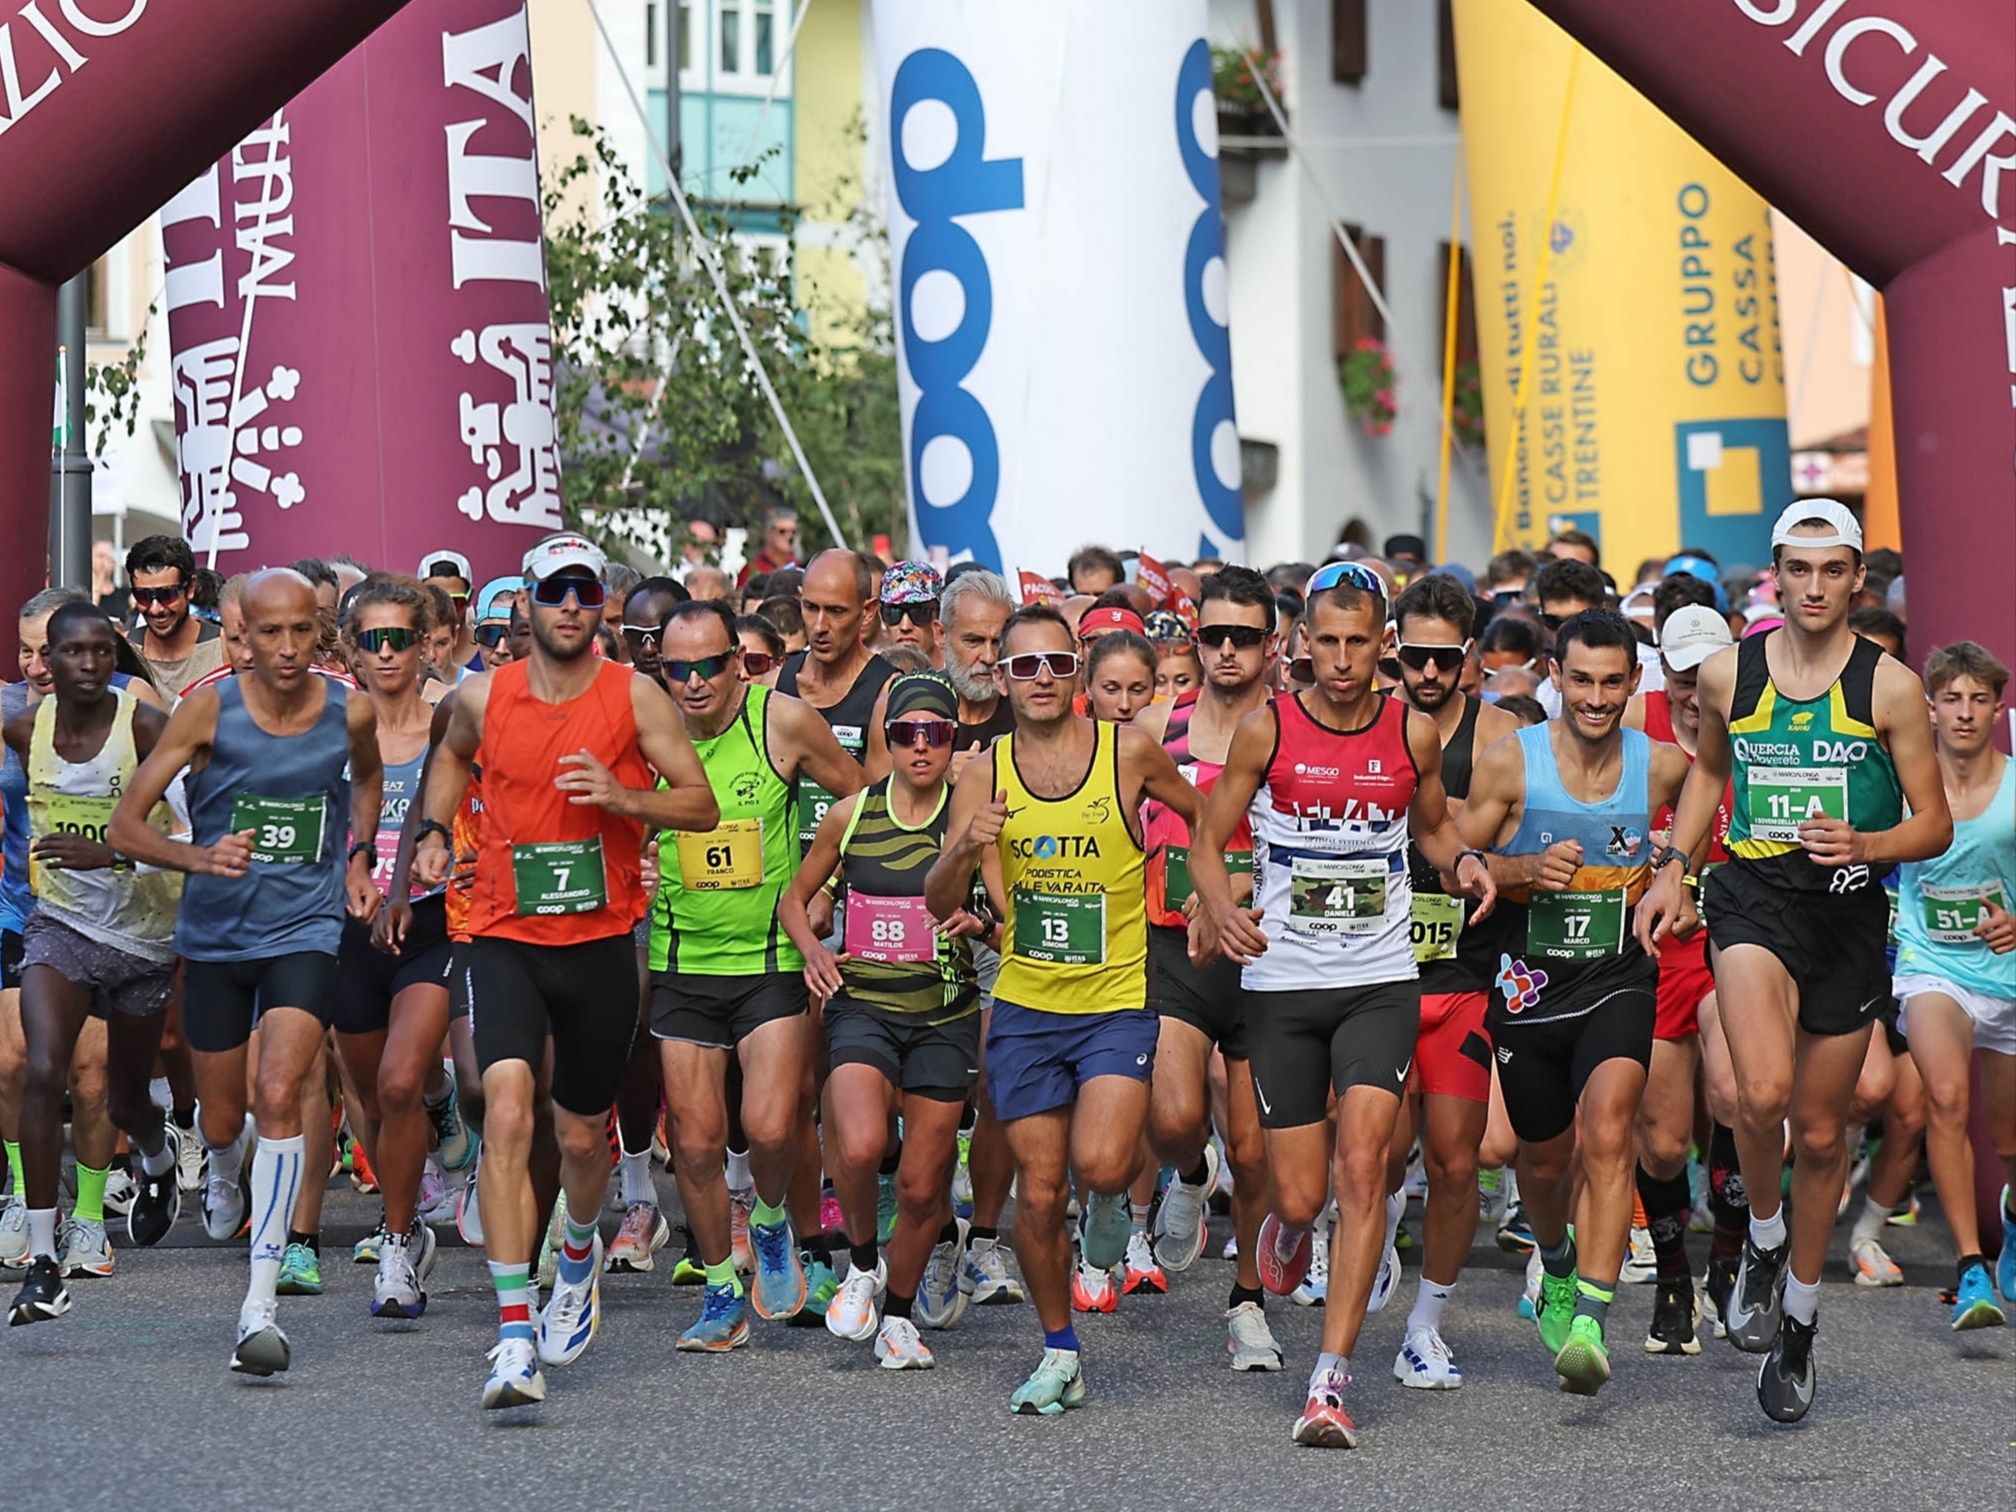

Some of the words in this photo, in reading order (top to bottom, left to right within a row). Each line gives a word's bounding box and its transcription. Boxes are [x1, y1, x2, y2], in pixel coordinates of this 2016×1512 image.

[1678, 183, 1719, 387] GRUPPO
[889, 47, 1025, 575] oop
[1732, 234, 1765, 385] CASSA
[1538, 282, 1562, 396] RURALI
[1570, 349, 1600, 502] TRENTINE
[1543, 406, 1567, 503] CASSE
[1734, 738, 1800, 762] QUERCIA
[1306, 766, 1339, 776] MESGO
[1767, 794, 1824, 818] 11-A
[259, 825, 296, 848] 39
[1768, 831, 1794, 840] coop
[250, 852, 274, 863] oop
[706, 846, 732, 867] 61
[1010, 835, 1100, 859] SCOTTA
[553, 868, 570, 891] 7
[1025, 868, 1082, 879] PODISTICA
[541, 889, 590, 900] ALESSANDRO
[696, 881, 720, 889] coop
[536, 904, 565, 914] coop
[1325, 886, 1354, 910] 41
[1309, 922, 1337, 932] coop
[1564, 915, 1591, 937] 17
[1936, 906, 1991, 929] 51-A
[871, 920, 905, 941] 88
[1041, 918, 1069, 941] 13
[1028, 949, 1054, 961] coop
[1041, 940, 1069, 949] SIMONE
[1547, 948, 1575, 959] coop
[861, 951, 887, 961] coop
